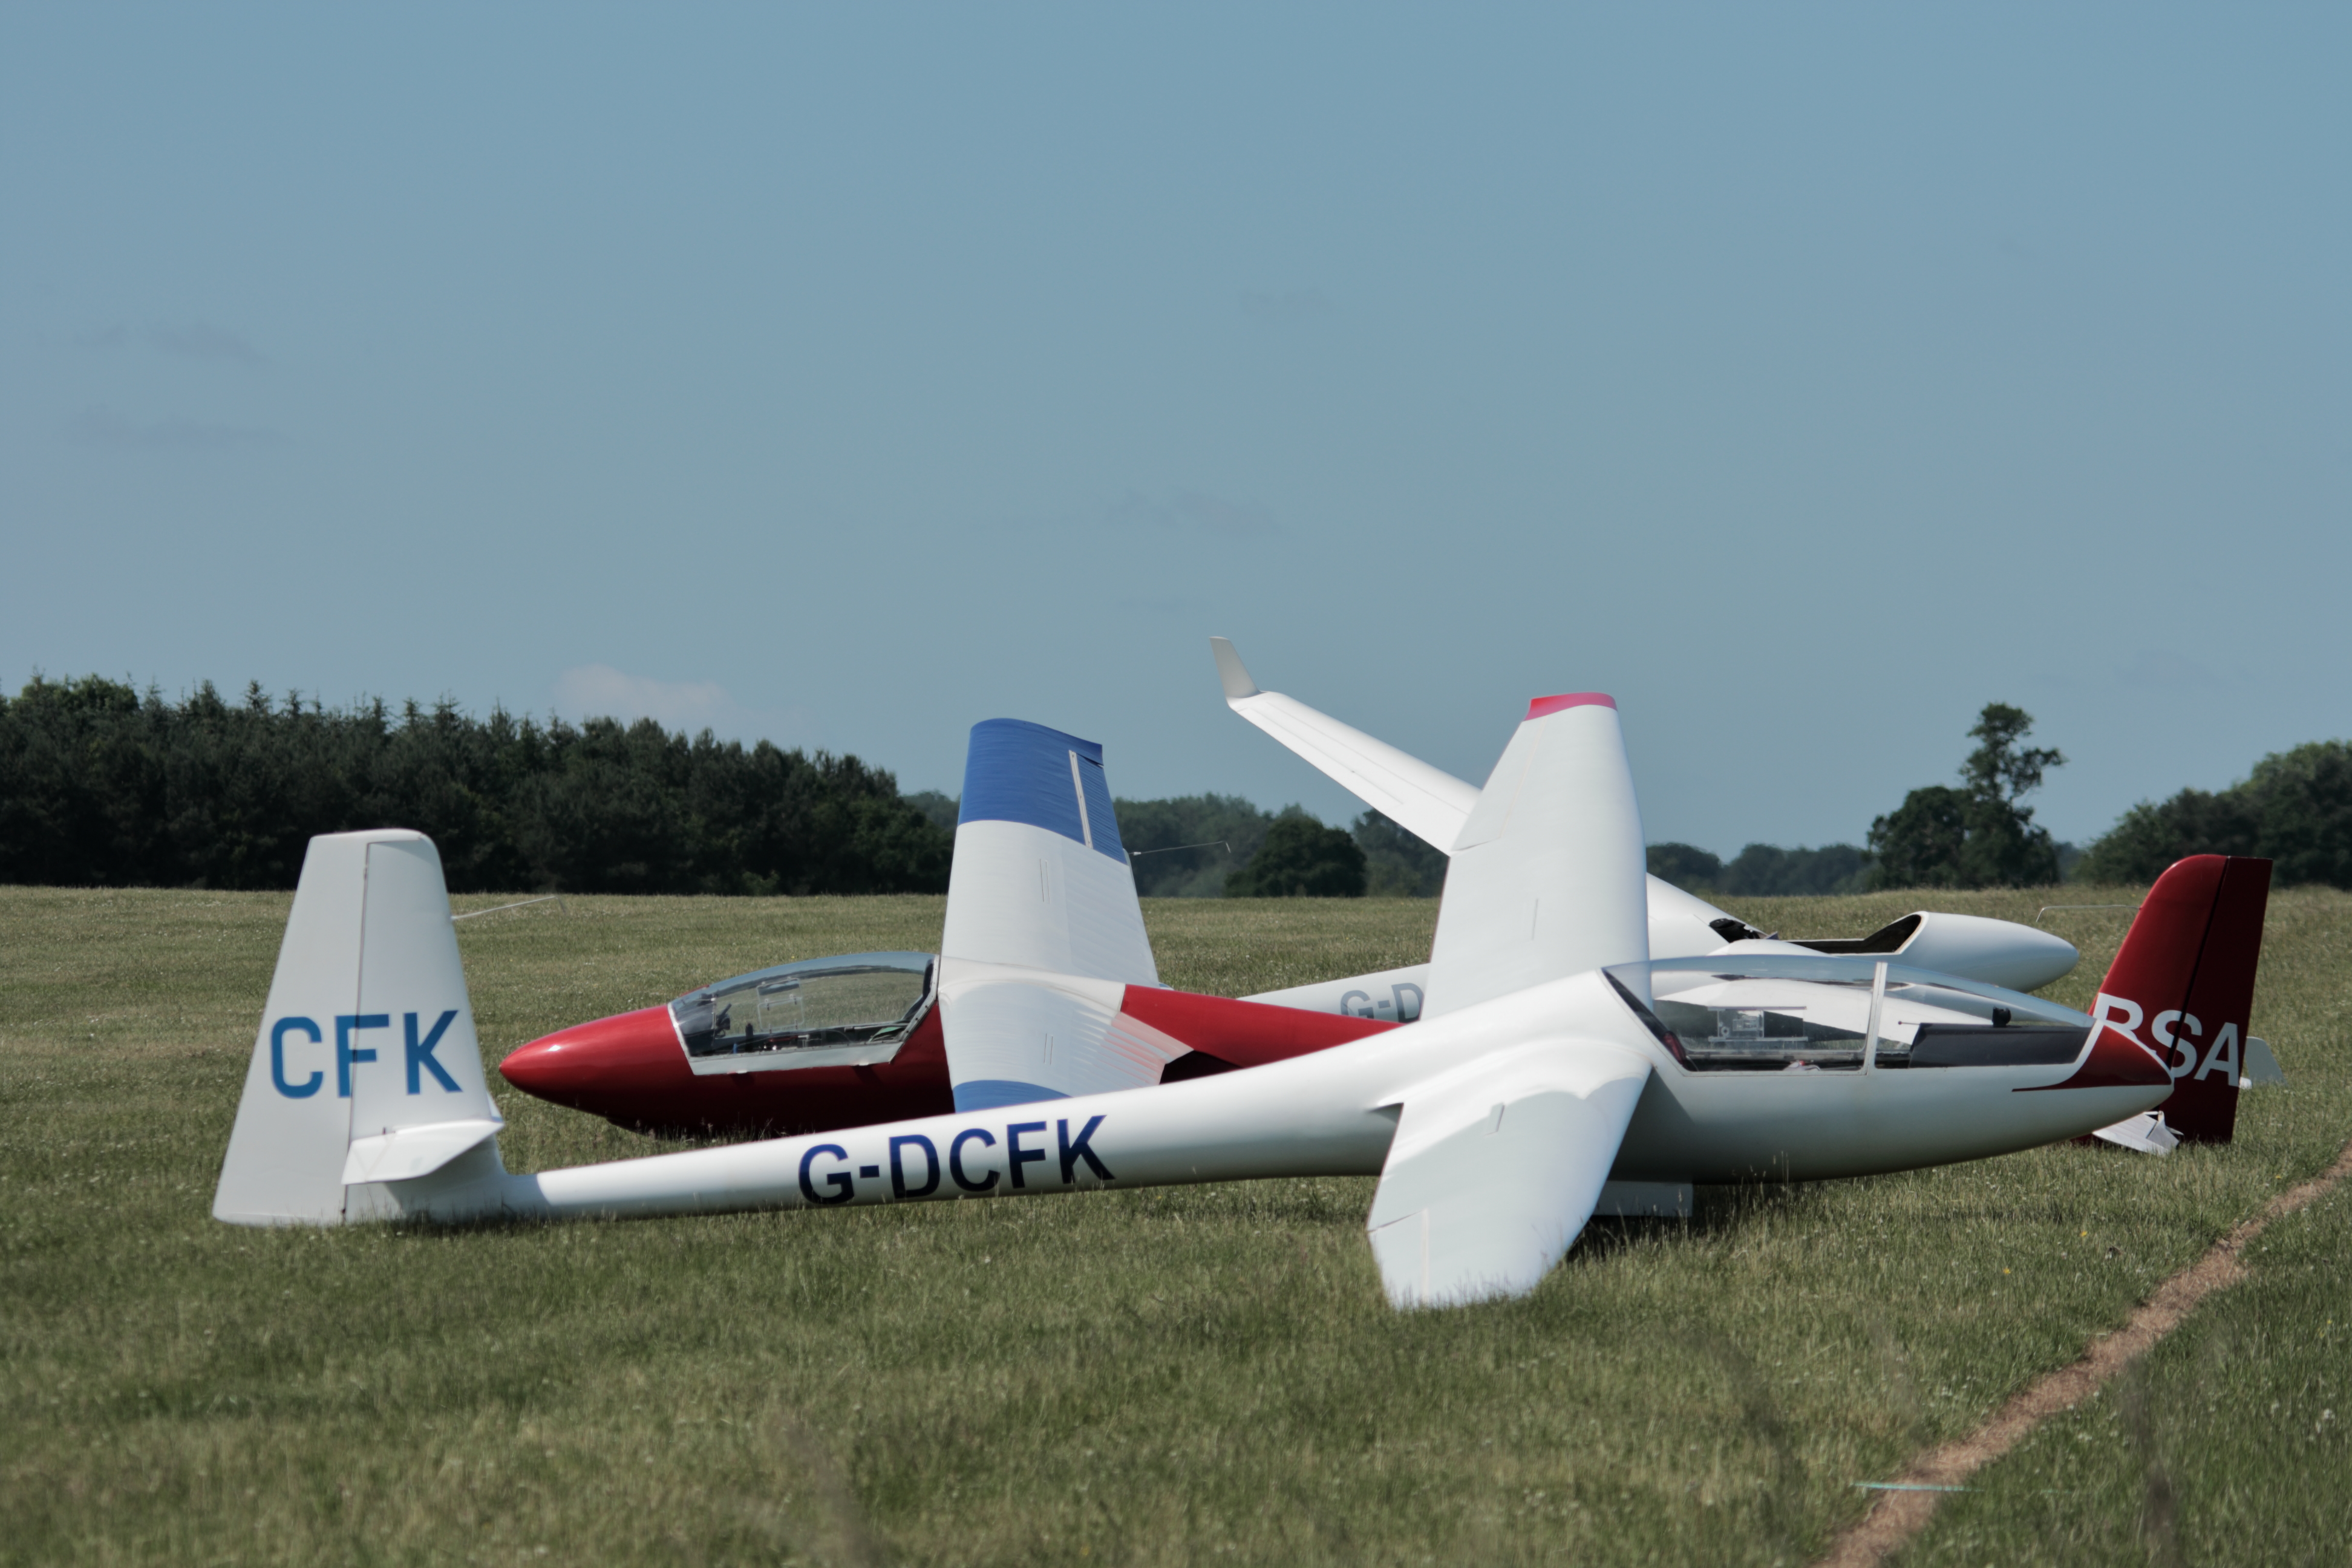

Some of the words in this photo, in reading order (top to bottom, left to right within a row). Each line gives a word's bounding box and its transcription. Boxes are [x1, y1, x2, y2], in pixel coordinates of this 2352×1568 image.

[270, 1010, 463, 1100] CFK
[2092, 992, 2239, 1088] RSA
[798, 1114, 1116, 1204] G-DCFK
